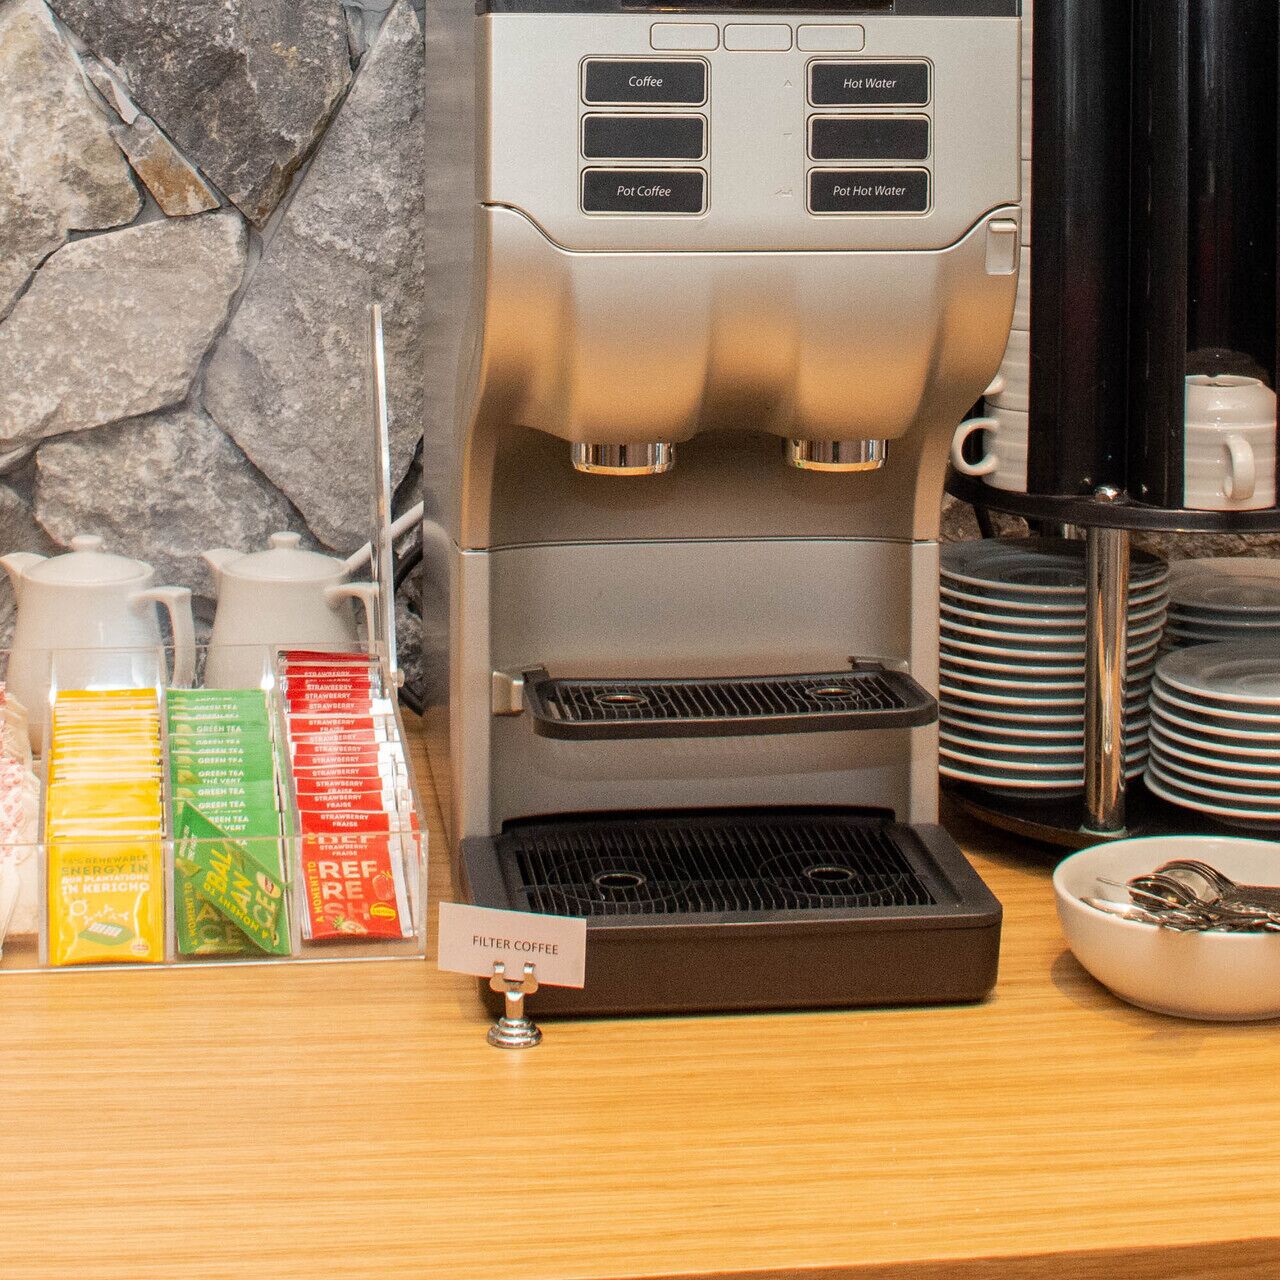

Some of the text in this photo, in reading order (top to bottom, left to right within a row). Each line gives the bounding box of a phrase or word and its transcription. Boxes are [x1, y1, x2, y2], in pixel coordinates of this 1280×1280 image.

[628, 75, 663, 87] Coffee
[843, 78, 897, 89] Hot Water
[616, 185, 672, 197] Pot Coffee
[832, 185, 906, 196] Pot Hot Water
[312, 756, 360, 764] STRAWBERRY
[197, 770, 227, 778] GREEN
[312, 768, 360, 776] STRAWBERRY
[315, 780, 363, 788] STRAWBERRY
[197, 787, 246, 796] GREEN TEA
[314, 794, 362, 802] STRAWBERRY
[197, 800, 246, 809] GREEN TEA
[232, 815, 250, 823] TEA
[320, 813, 369, 821] STRAWBERRY
[224, 824, 247, 832] VERT
[61, 863, 150, 876] ENERGY IN
[306, 861, 317, 874] TO
[317, 860, 379, 880] REF
[84, 873, 151, 883] PLANTATIONS
[62, 882, 151, 895] IN KERICHO
[322, 880, 365, 900] RE
[309, 875, 323, 914] MOMENT
[218, 895, 261, 933] MOMENT
[472, 935, 559, 956] FILTER COFFEE
